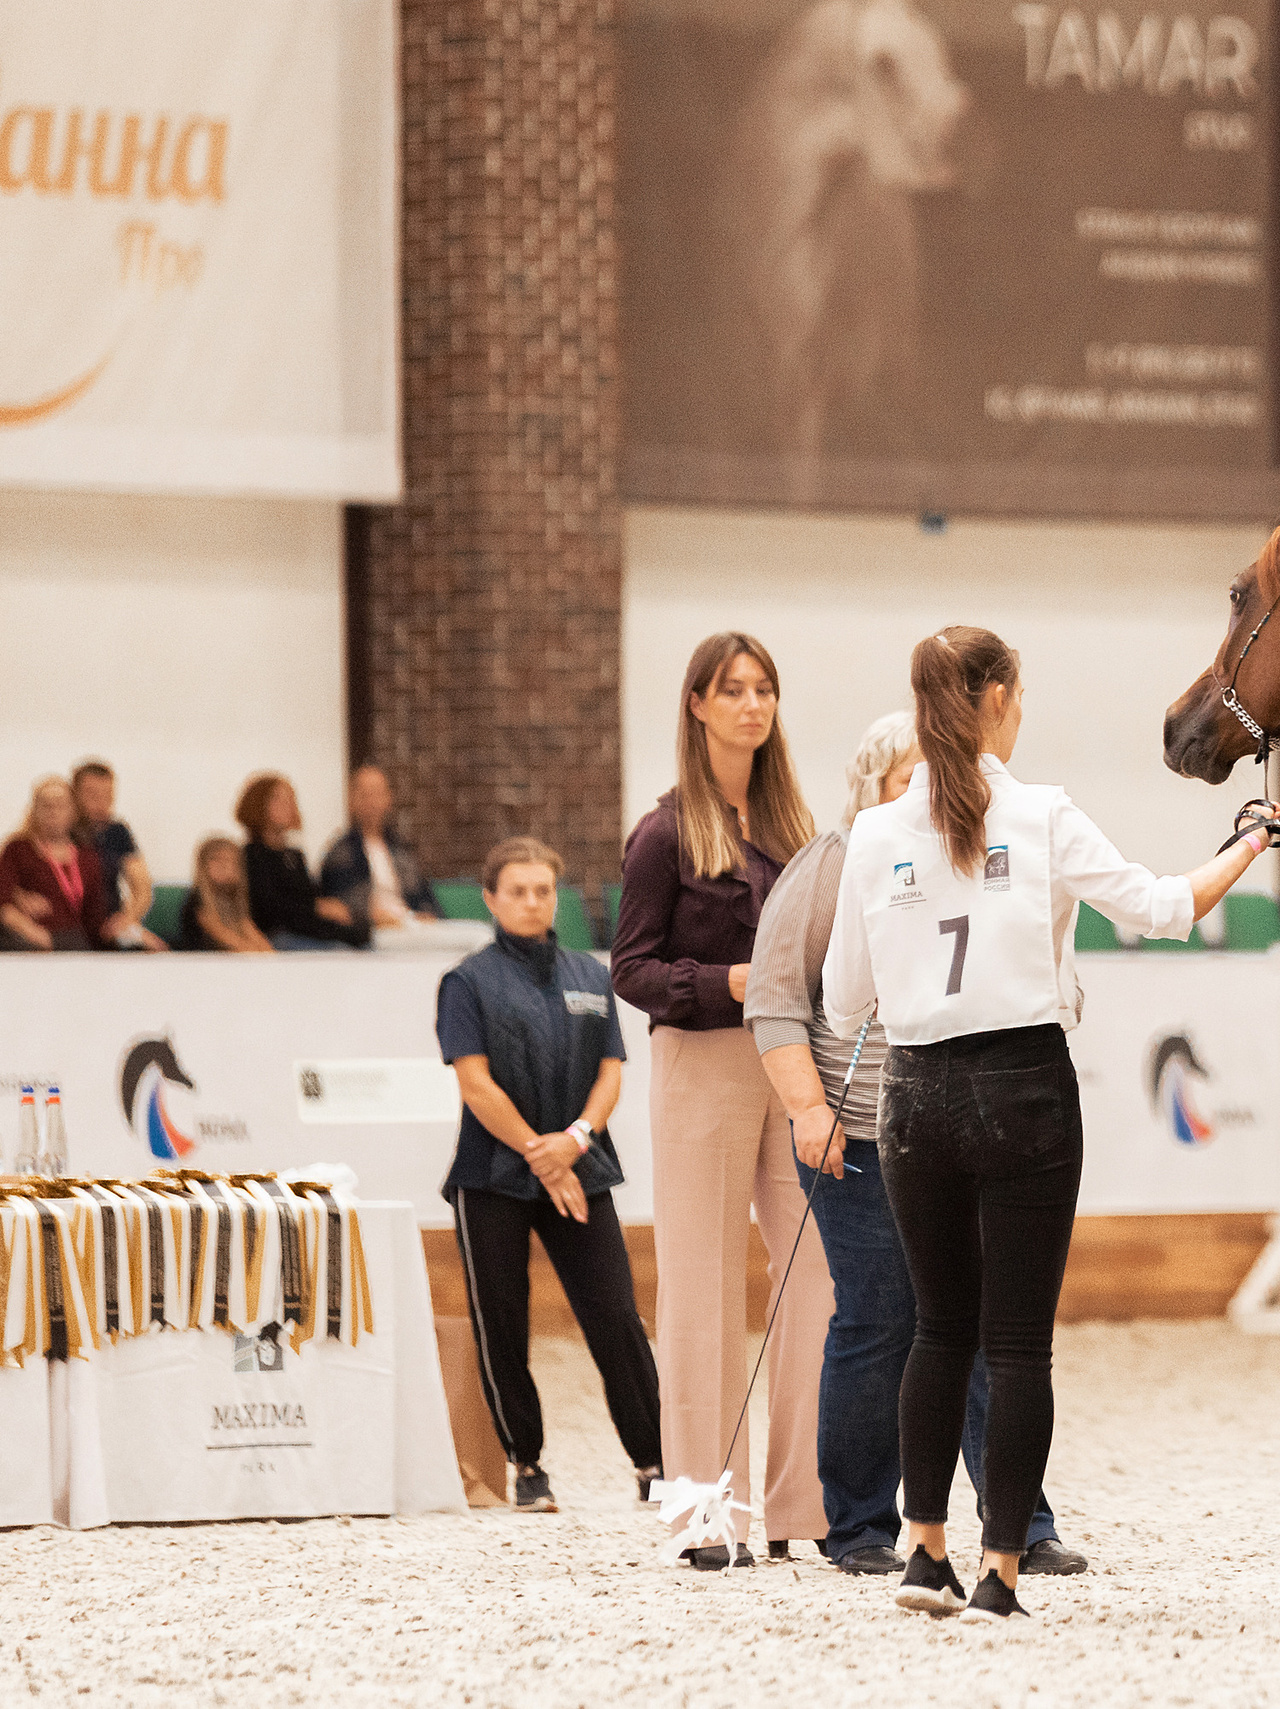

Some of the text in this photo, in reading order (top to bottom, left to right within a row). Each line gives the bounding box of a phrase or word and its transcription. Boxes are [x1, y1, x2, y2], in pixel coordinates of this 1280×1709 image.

[1011, 3, 1261, 97] TAMAR
[890, 890, 923, 903] MAXIMA
[938, 914, 970, 996] 7
[211, 1402, 308, 1430] MAXIMA
